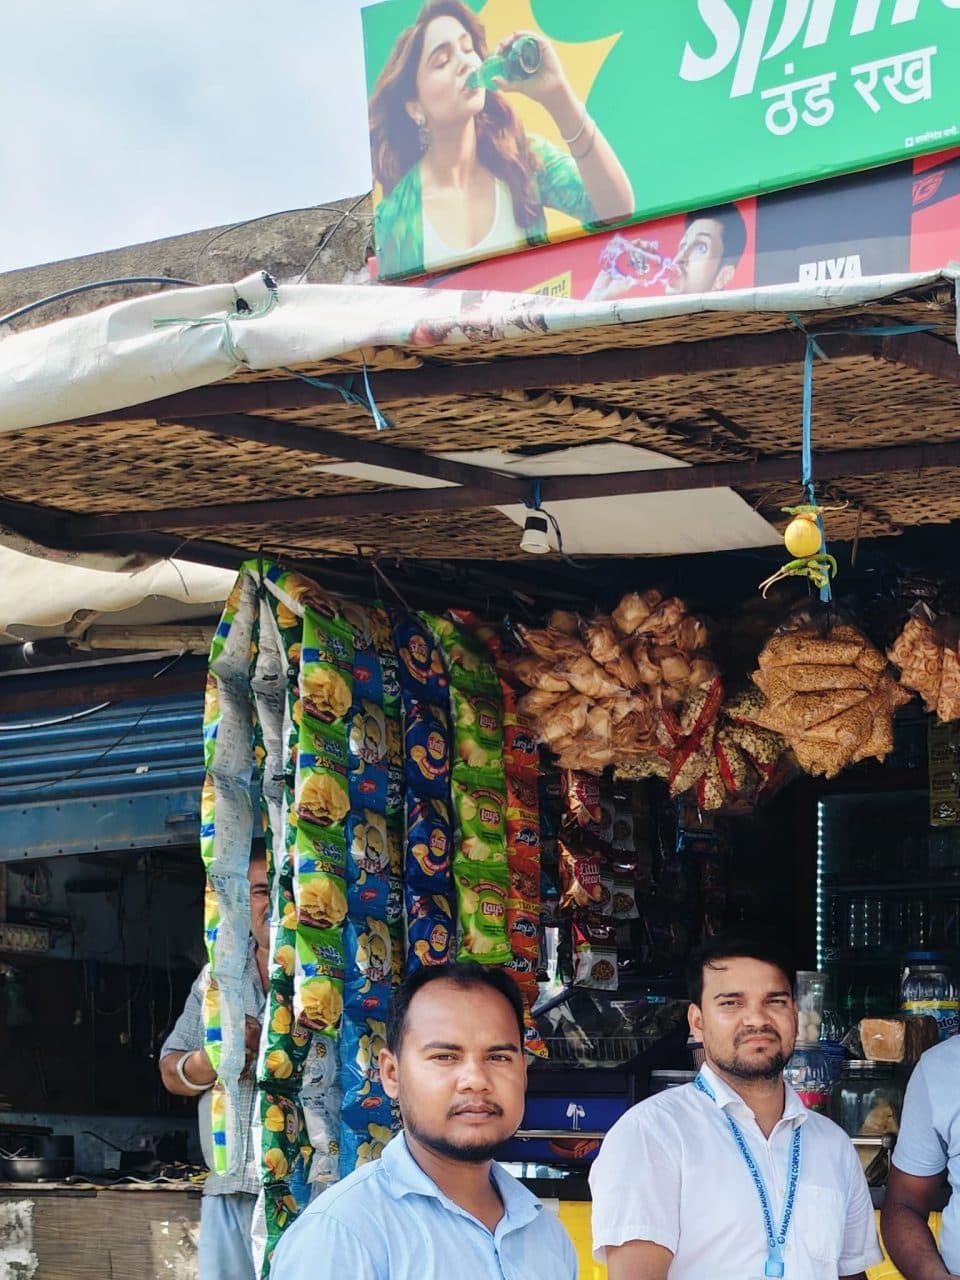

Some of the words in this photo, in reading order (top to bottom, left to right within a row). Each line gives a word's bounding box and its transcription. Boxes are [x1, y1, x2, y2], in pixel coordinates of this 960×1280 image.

[761, 62, 837, 135] ठंड
[851, 46, 937, 113] रख
[764, 1209, 775, 1238] MANGO
[780, 1209, 791, 1237] MANGO
[786, 1175, 798, 1209] MUNICIPAL
